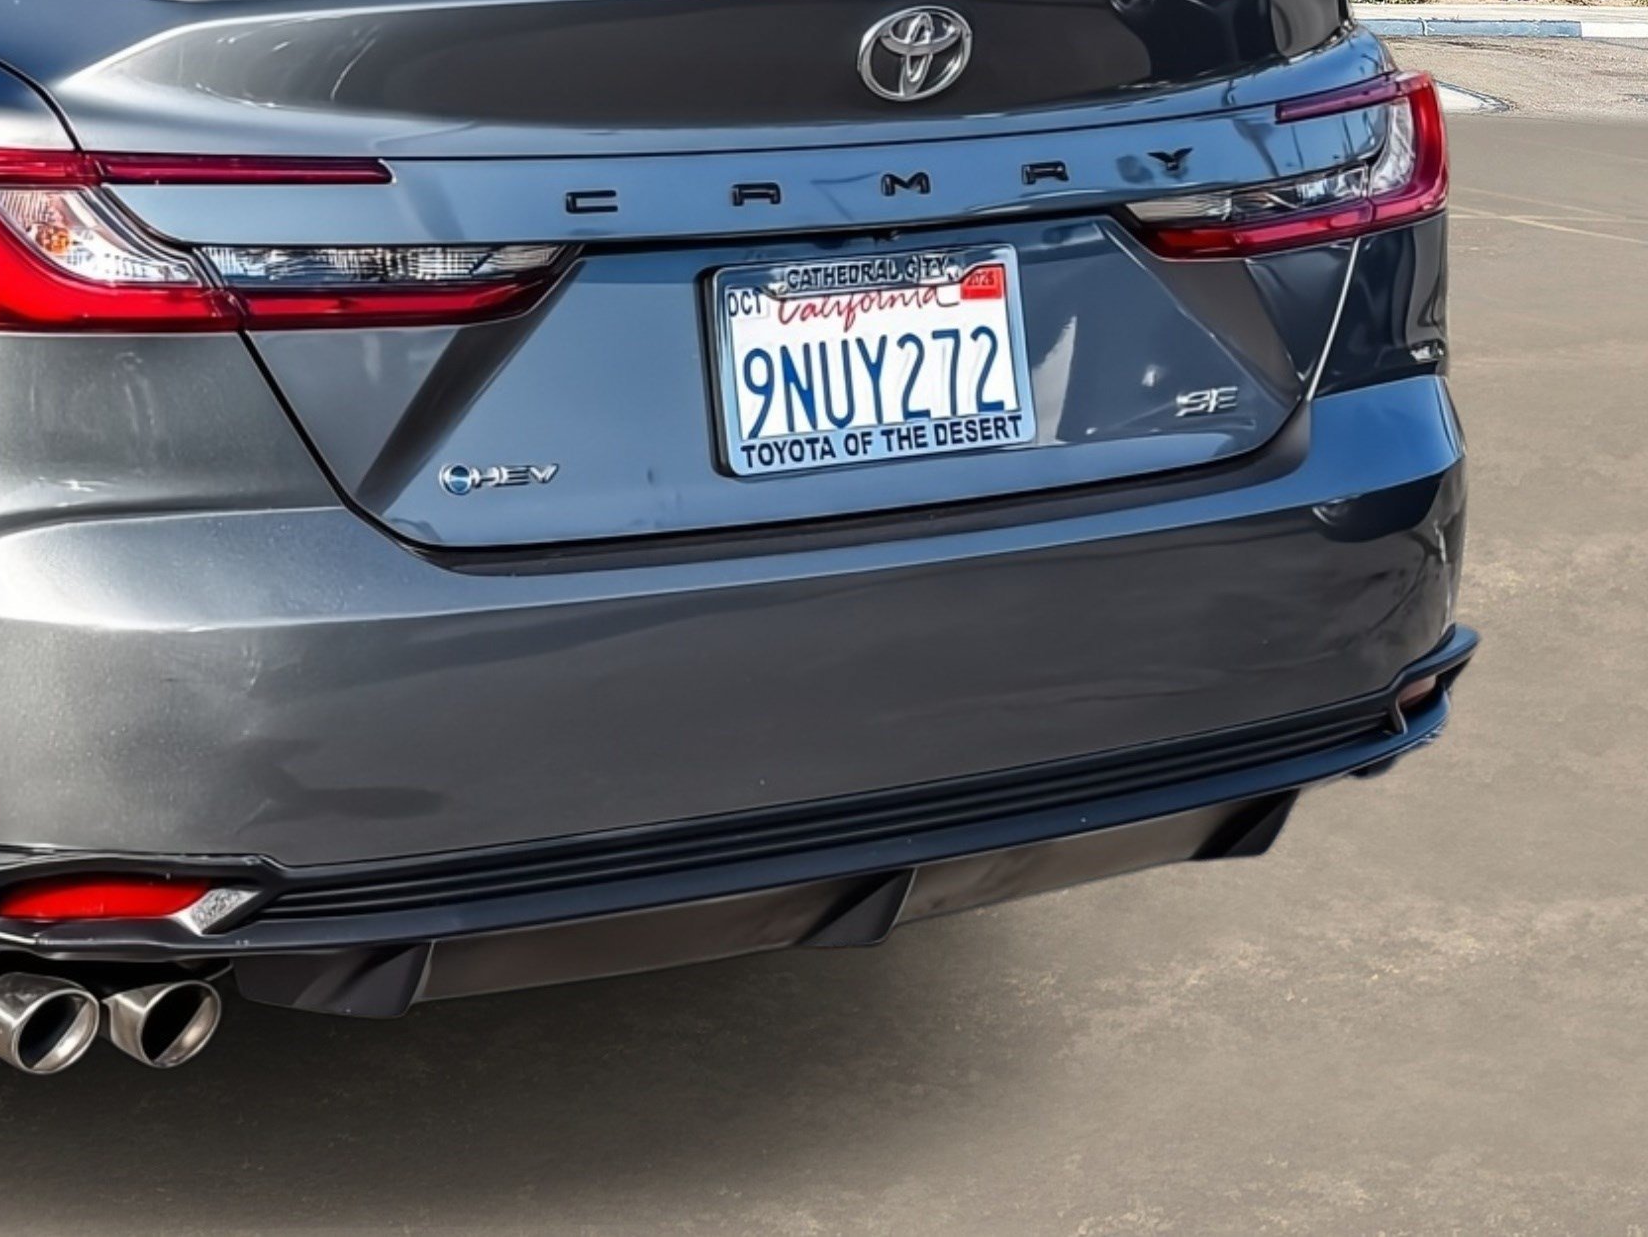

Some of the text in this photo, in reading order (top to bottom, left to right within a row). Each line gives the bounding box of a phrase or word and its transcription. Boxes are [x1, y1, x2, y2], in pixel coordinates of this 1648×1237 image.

[565, 148, 1193, 215] CAMRY
[786, 253, 950, 289] CATHEDRAL CITY
[727, 287, 764, 317] OCT
[742, 325, 1005, 439] 9NUY272
[1175, 386, 1238, 417] SE
[740, 415, 1023, 468] TOYOTA OF THE DESERT
[471, 463, 559, 489] HEV
